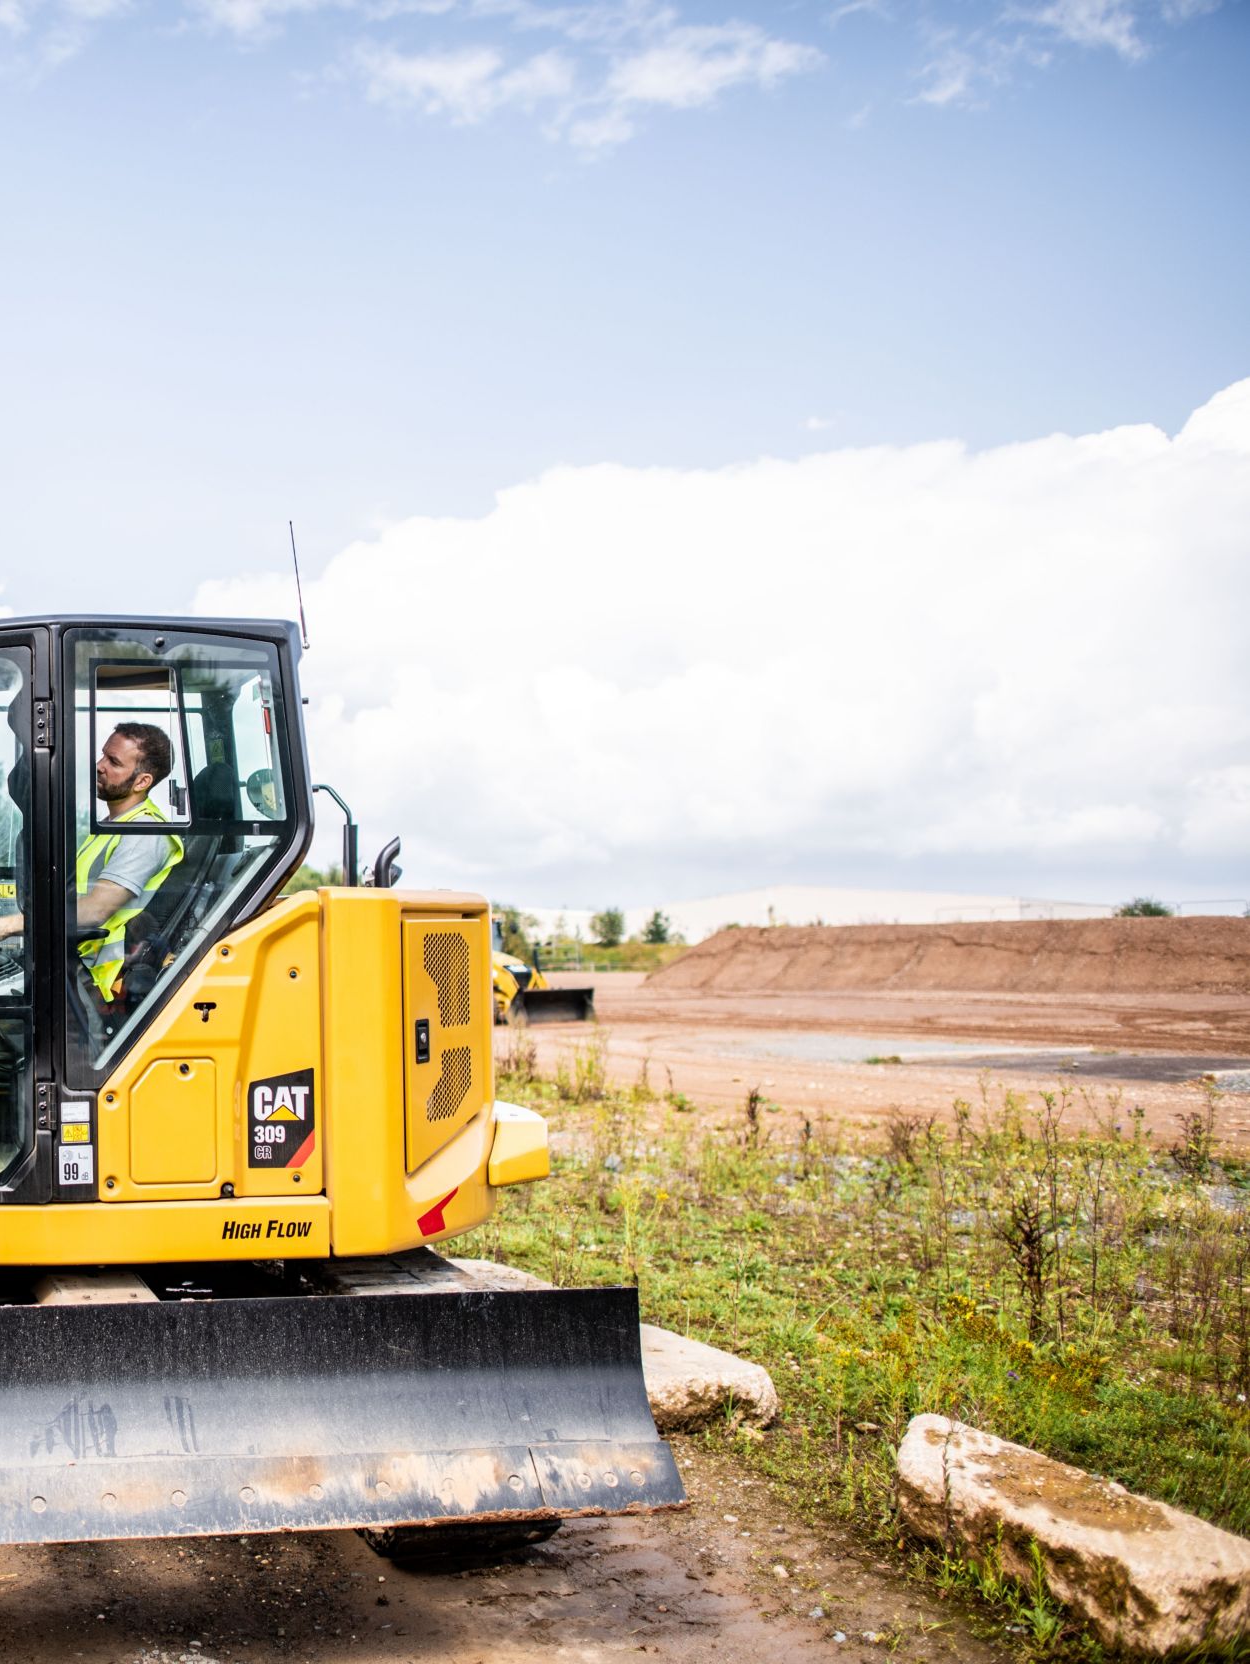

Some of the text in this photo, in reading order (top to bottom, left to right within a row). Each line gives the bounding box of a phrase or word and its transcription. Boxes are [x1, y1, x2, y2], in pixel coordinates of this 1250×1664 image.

[253, 1086, 309, 1121] CAT
[254, 1125, 286, 1143] 309
[254, 1145, 272, 1160] CR
[64, 1163, 79, 1181] 99
[222, 1220, 312, 1239] HIGH FLOW
